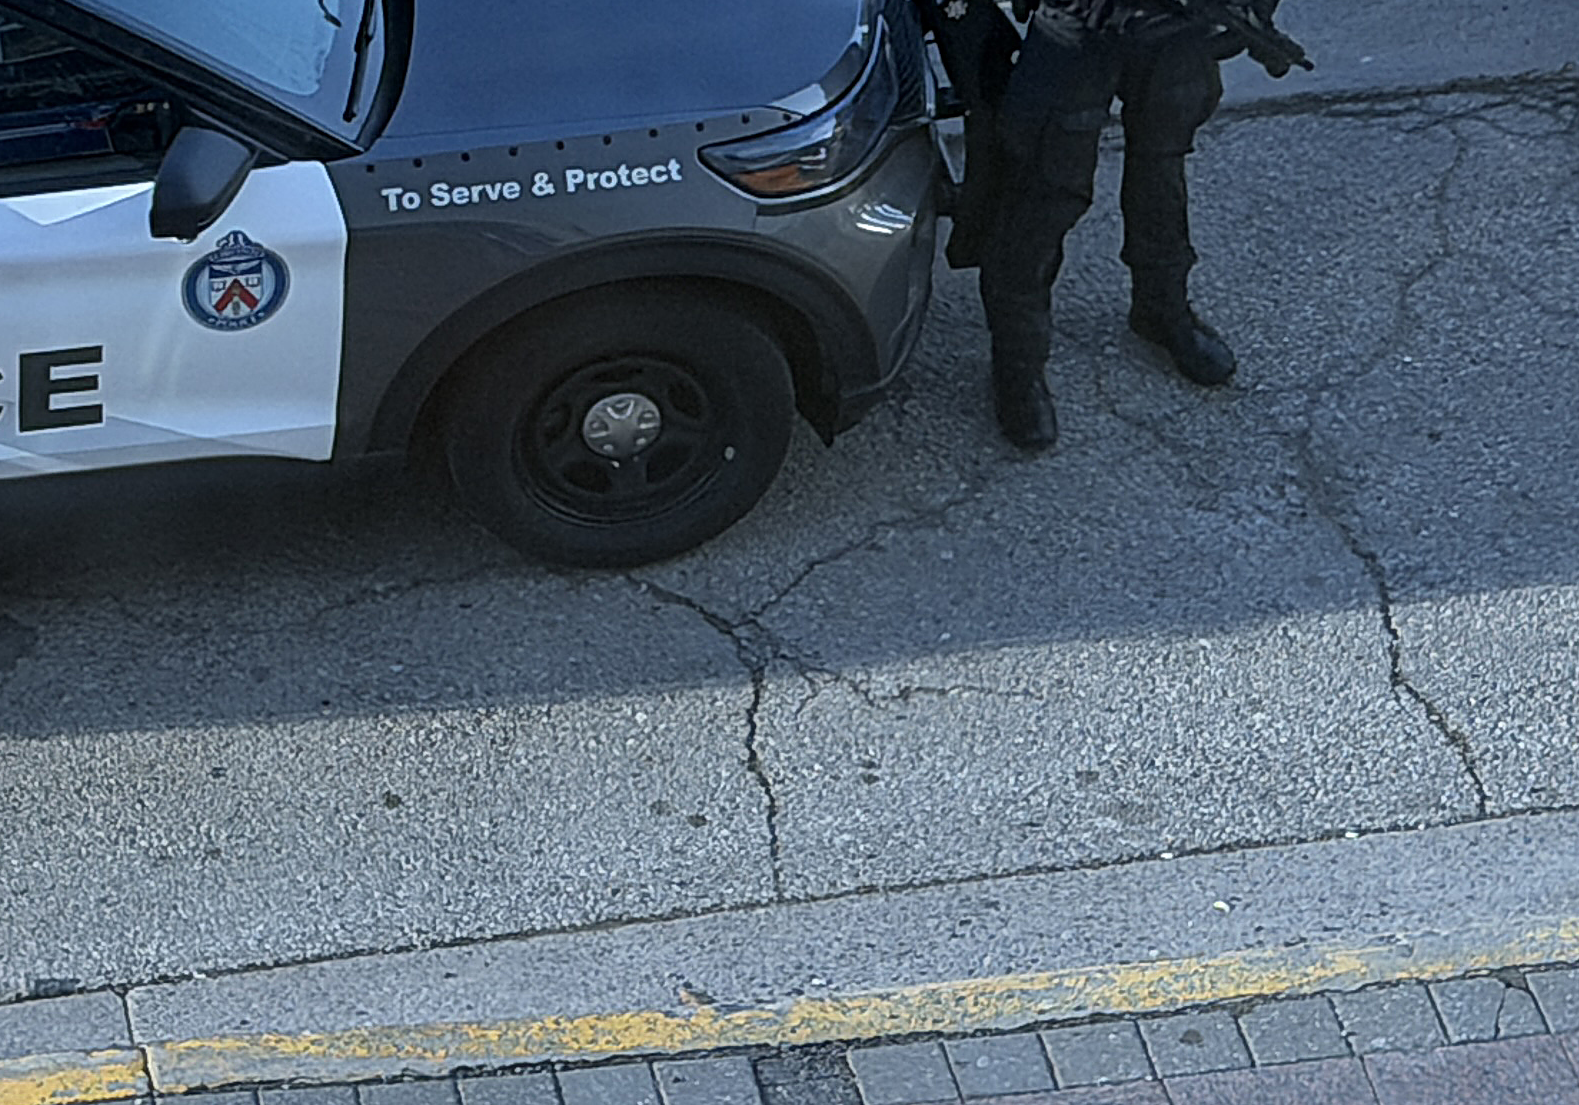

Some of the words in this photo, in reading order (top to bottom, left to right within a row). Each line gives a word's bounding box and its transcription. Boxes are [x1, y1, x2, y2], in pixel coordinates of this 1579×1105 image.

[381, 187, 421, 211] To
[430, 181, 521, 207] Serve
[531, 172, 556, 196] &
[565, 158, 683, 193] Protect
